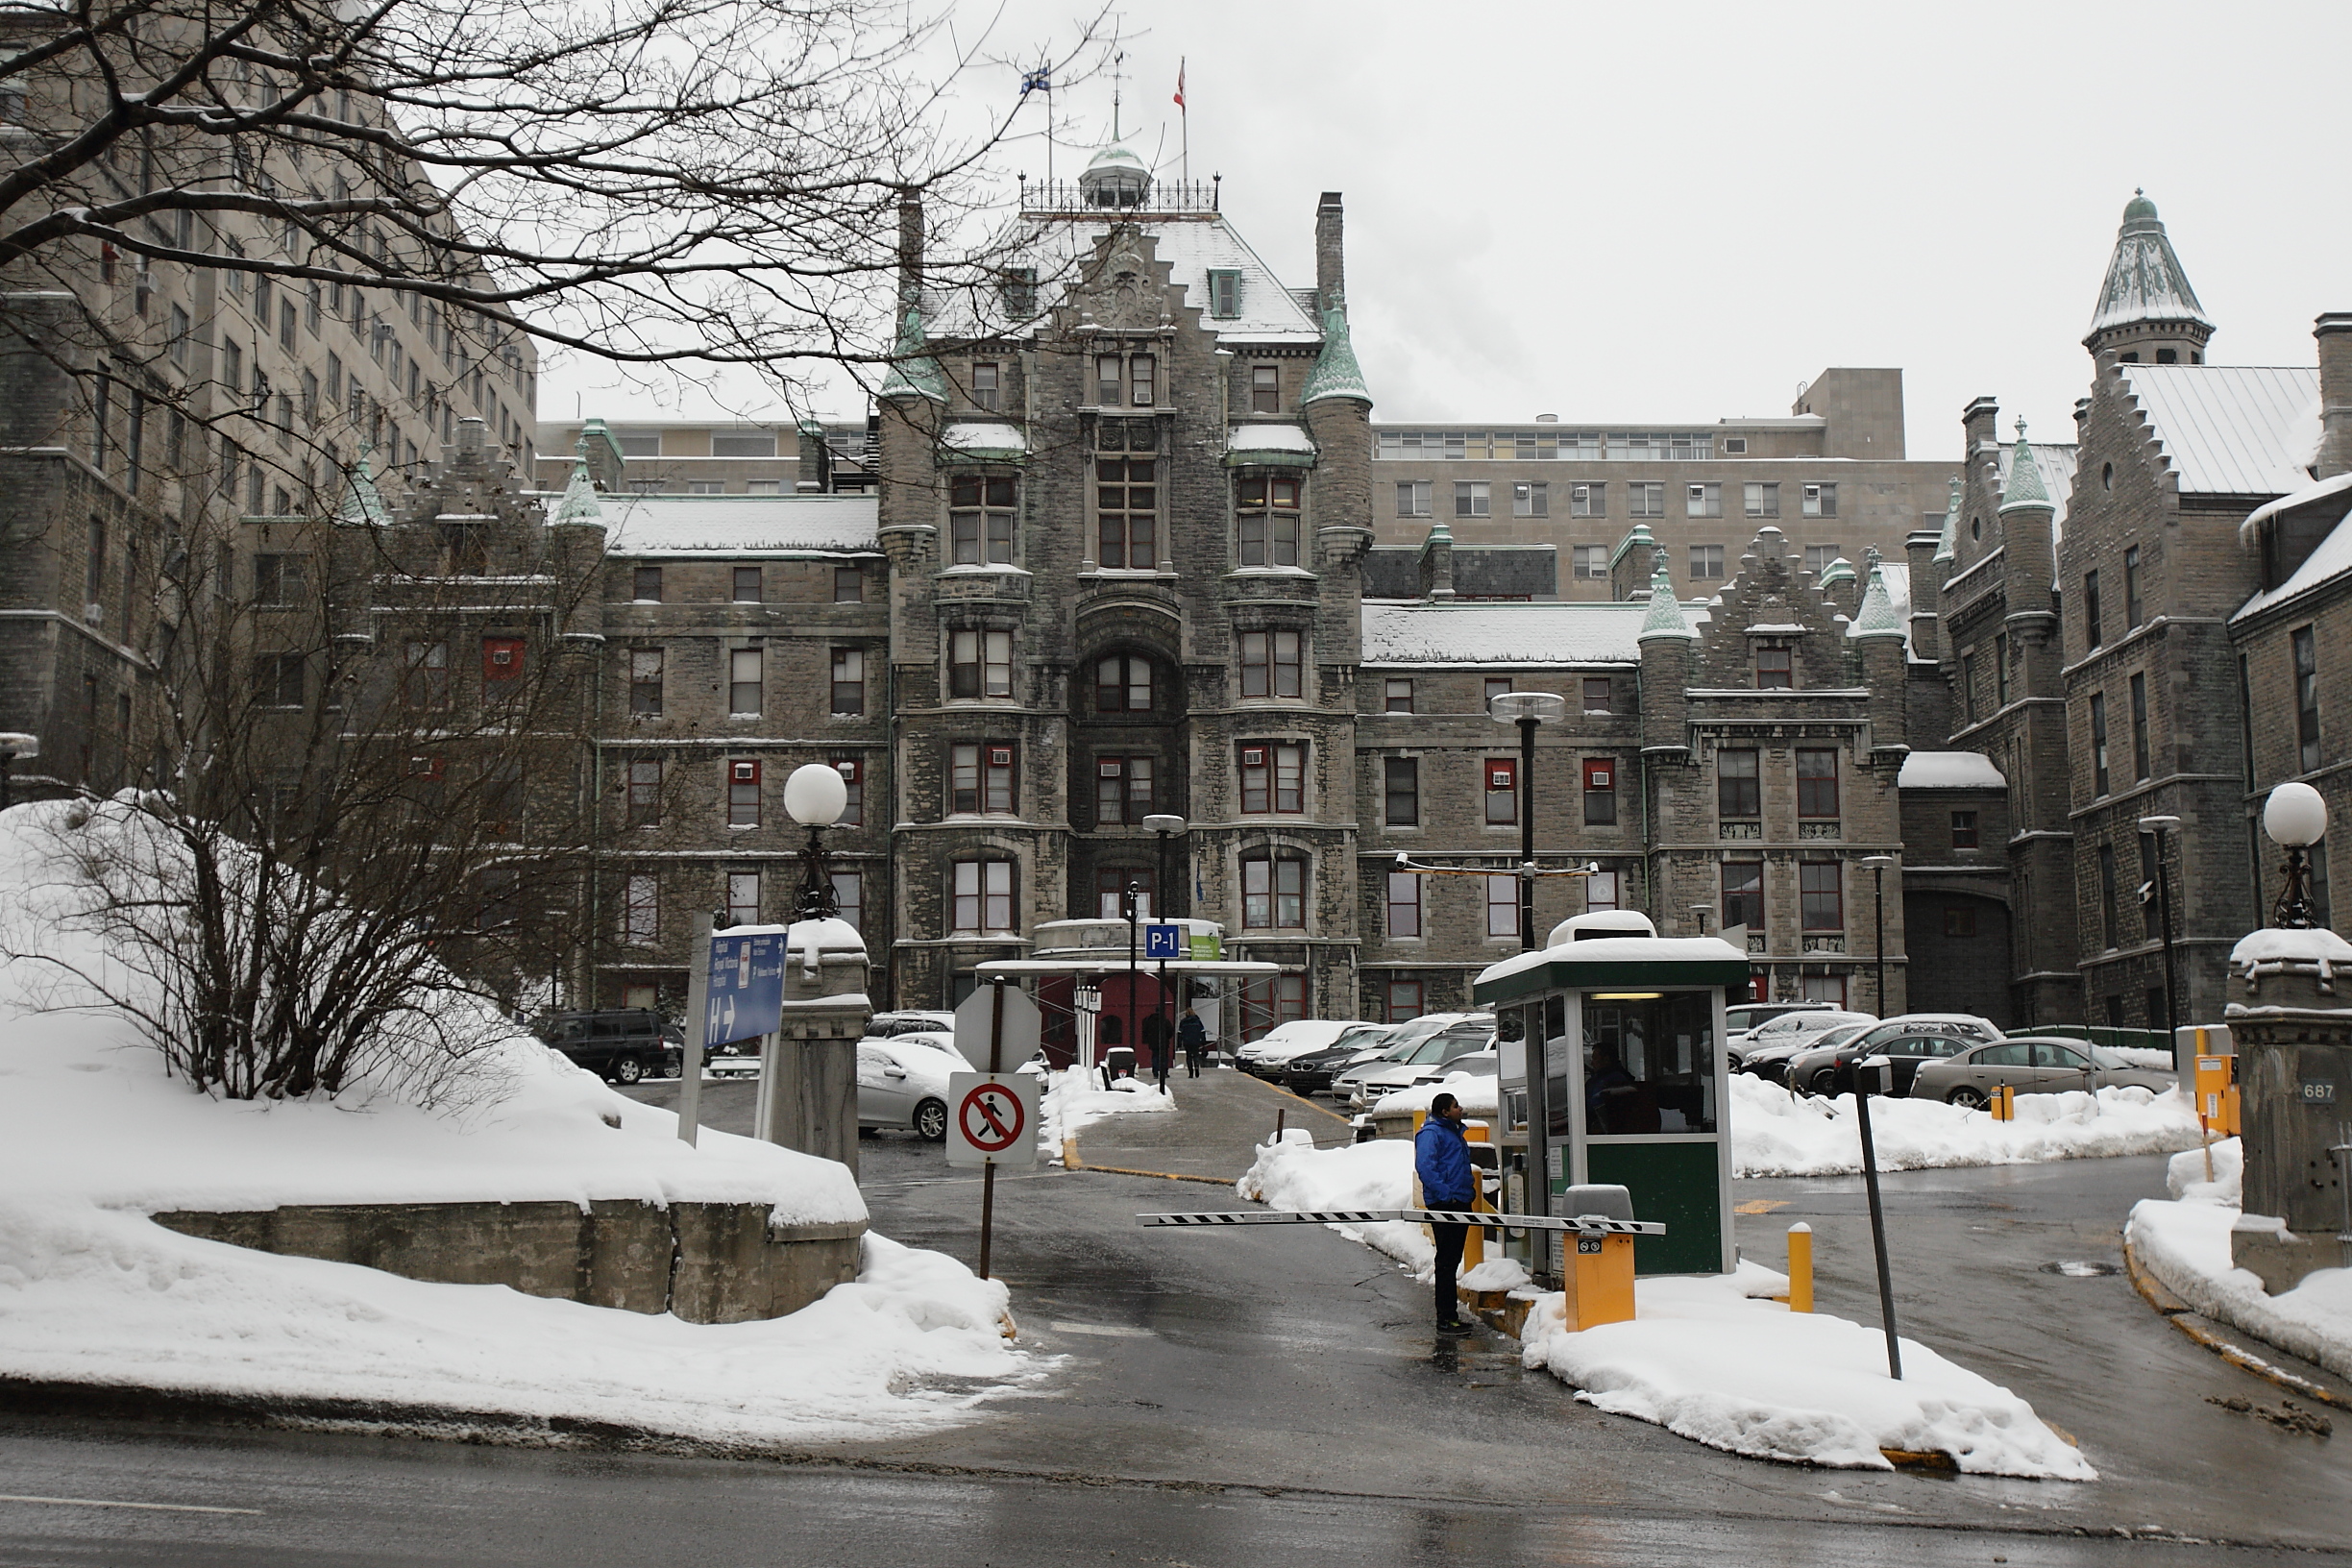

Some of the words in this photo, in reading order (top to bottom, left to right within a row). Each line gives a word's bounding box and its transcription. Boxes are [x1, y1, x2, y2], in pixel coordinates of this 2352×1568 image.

[1152, 933, 1173, 949] P-1
[708, 996, 721, 1044] H
[2304, 1084, 2333, 1098] 687
